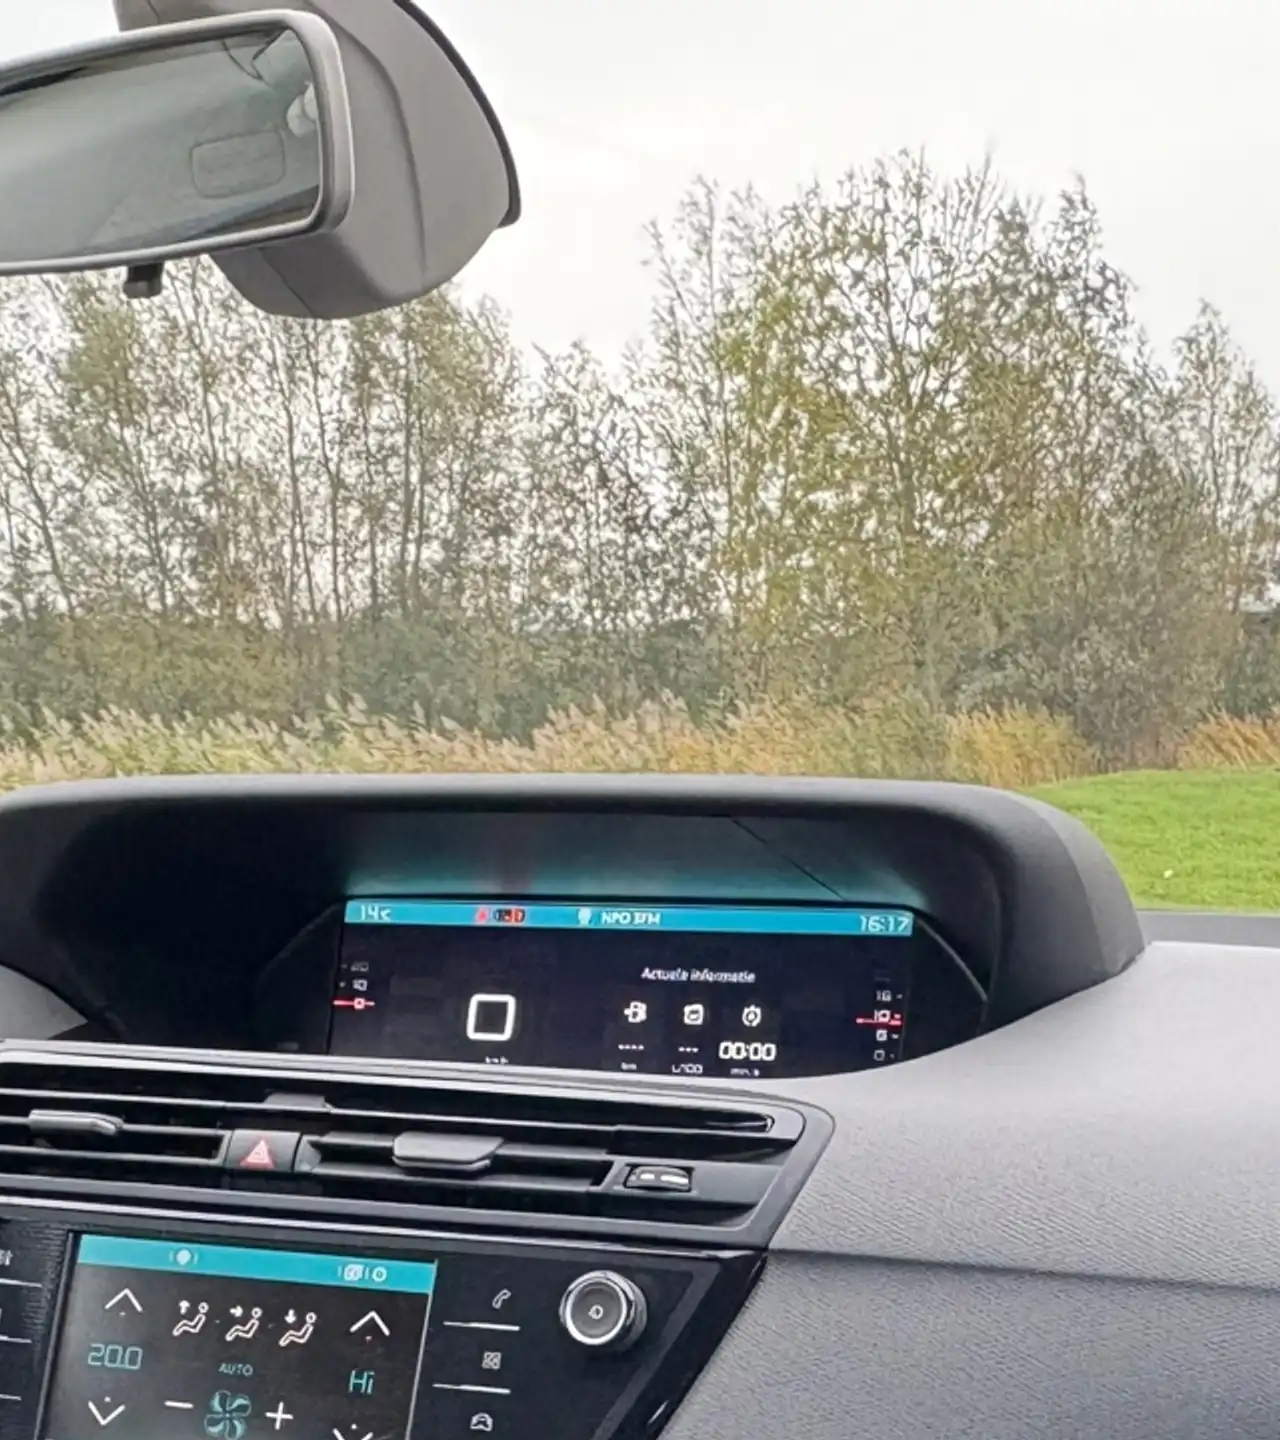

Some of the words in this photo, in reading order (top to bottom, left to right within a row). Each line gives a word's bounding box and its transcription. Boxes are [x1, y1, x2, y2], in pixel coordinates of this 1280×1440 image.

[859, 913, 909, 933] 16:17
[718, 1040, 777, 1062] 00:00
[218, 1362, 254, 1376] AUTO
